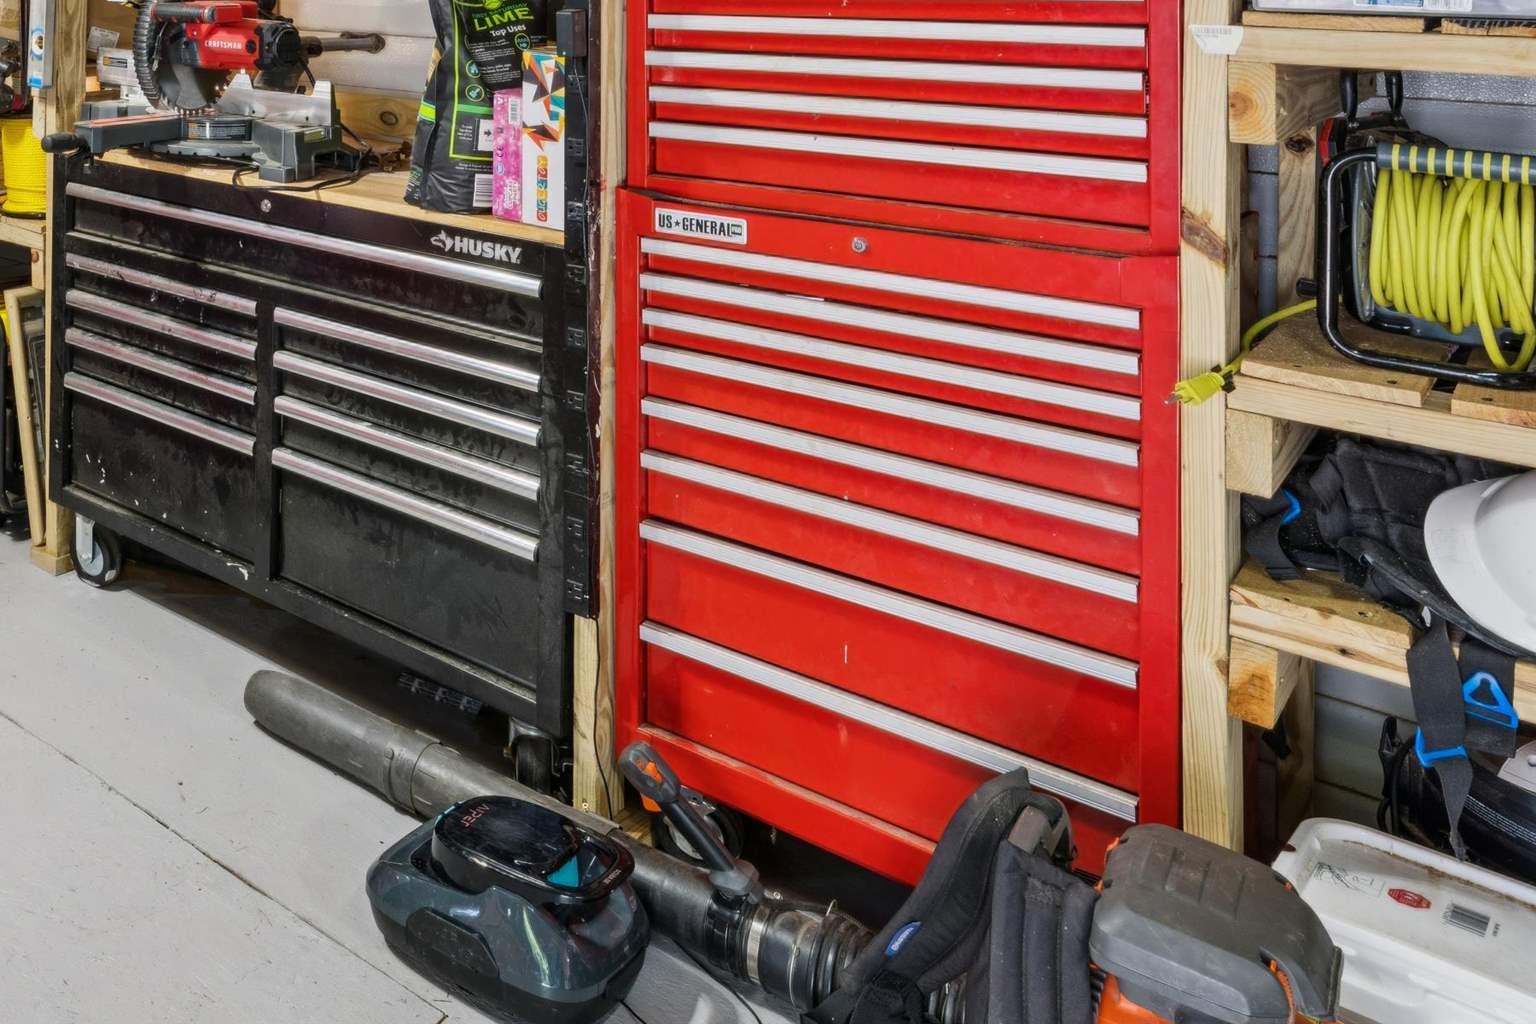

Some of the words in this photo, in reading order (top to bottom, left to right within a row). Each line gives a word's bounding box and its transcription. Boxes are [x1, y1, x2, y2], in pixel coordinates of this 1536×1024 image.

[474, 7, 535, 32] LIME
[490, 28, 506, 37] Top
[507, 24, 526, 33] Uses
[204, 40, 241, 50] CRAFTSMAN
[658, 212, 672, 229] US
[682, 217, 732, 238] GENERAL
[454, 235, 523, 264] HUSKY
